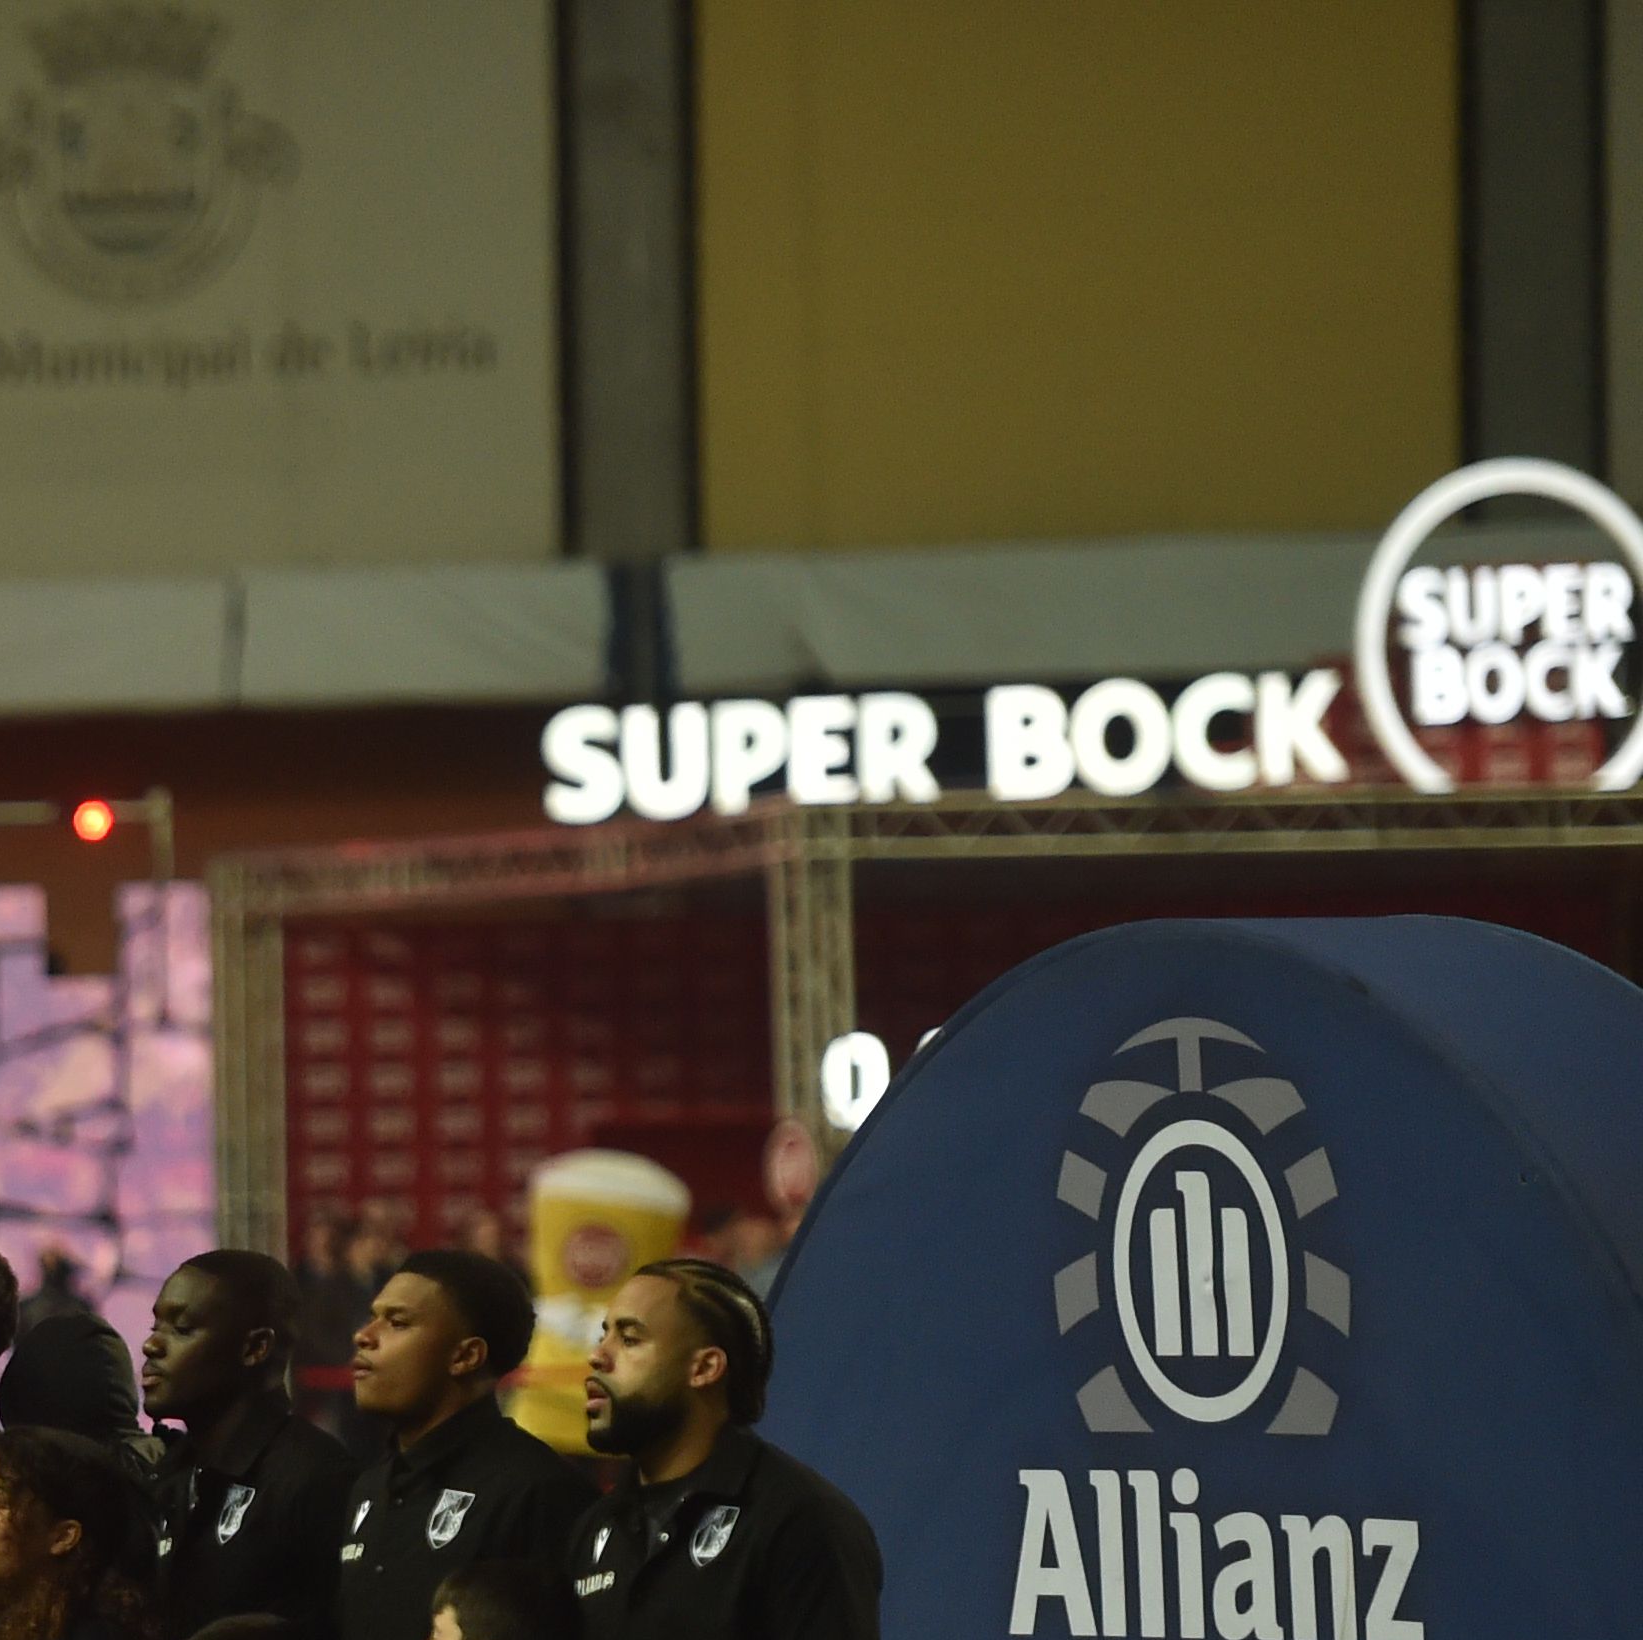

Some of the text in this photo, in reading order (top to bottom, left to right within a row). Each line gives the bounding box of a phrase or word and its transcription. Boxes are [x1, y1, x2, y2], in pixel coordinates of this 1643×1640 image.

[1397, 561, 1635, 648] SUPER
[1411, 638, 1629, 726] BOCK
[541, 669, 1351, 825] SUPER BOCK
